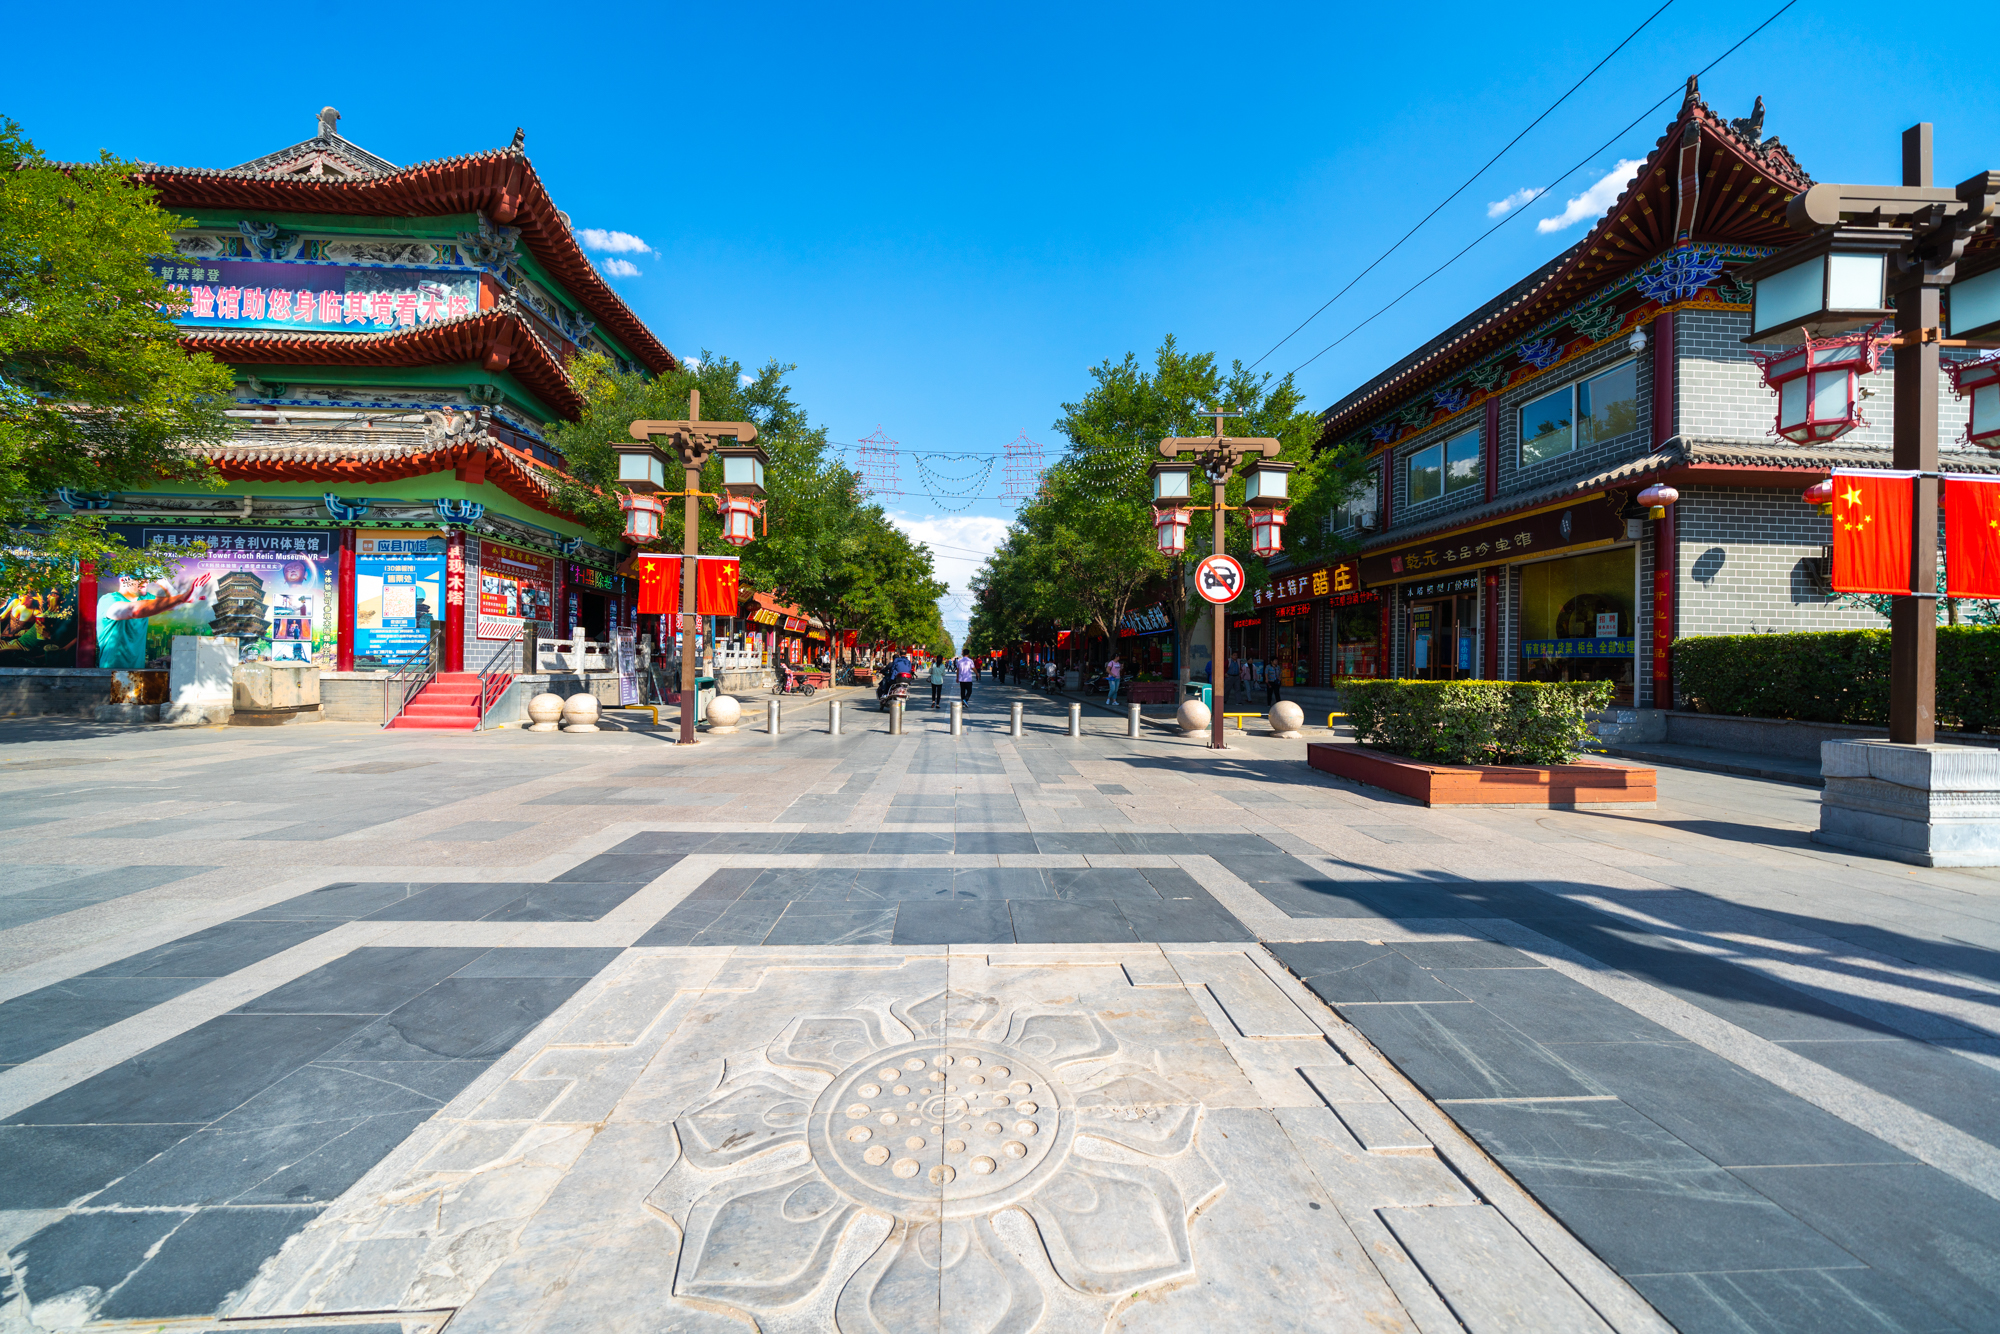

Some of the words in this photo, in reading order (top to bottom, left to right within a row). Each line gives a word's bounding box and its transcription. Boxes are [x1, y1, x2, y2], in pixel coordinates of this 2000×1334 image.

[161, 266, 220, 282] 暂禁攀登
[378, 540, 428, 552] 应县木塔
[233, 552, 254, 560] Tooth
[256, 552, 274, 560] Relic
[275, 553, 307, 561] Museum
[307, 553, 318, 561] VR
[387, 574, 412, 583] 售票处
[447, 545, 465, 606] 再现木塔
[1312, 563, 1353, 596] 醋庄
[1599, 614, 1616, 623] 招聘
[1653, 591, 1668, 658] 开业礼品
[1460, 639, 1469, 668] 半价清仓
